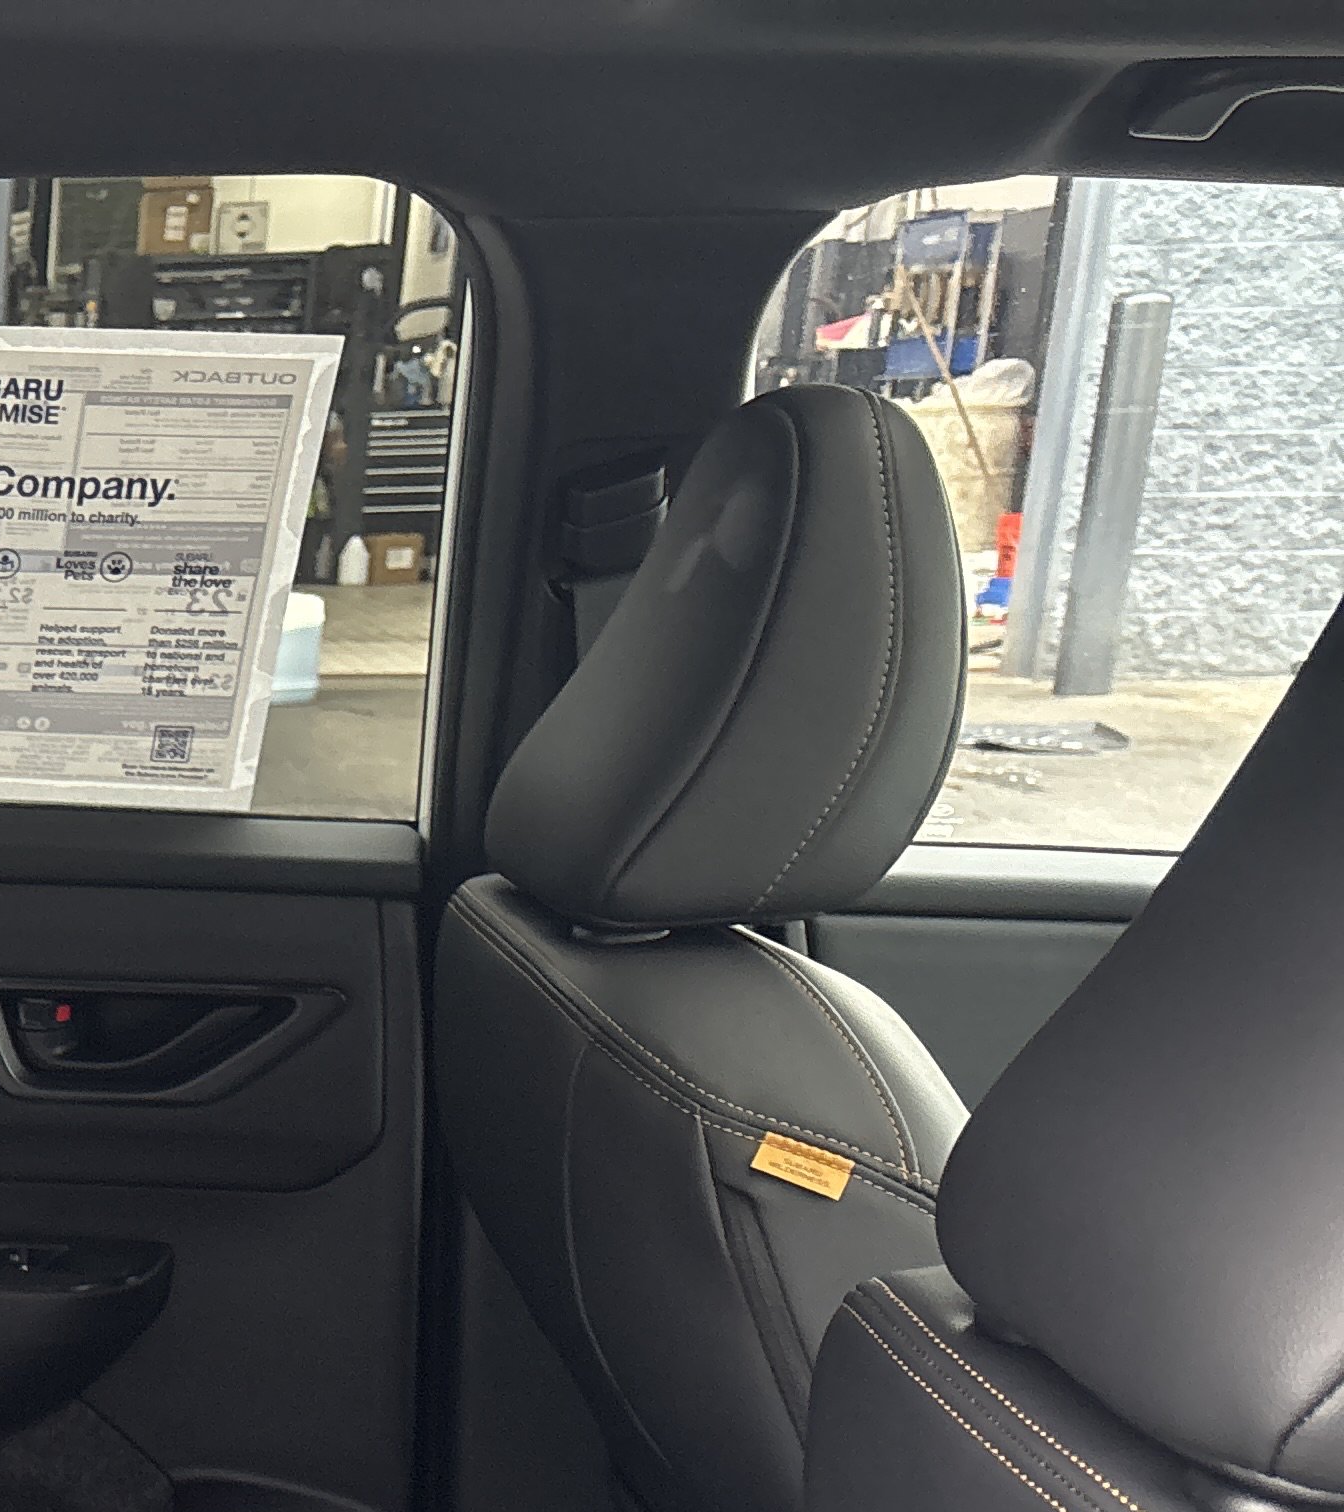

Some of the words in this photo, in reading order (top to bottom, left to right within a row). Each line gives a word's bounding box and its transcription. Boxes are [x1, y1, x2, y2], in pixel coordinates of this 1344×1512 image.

[18, 508, 66, 523] million
[71, 511, 85, 523] to
[89, 511, 141, 527] charity.
[55, 557, 96, 570] Loves
[173, 562, 221, 576] share
[63, 569, 94, 581] Pets
[171, 575, 199, 588] the
[199, 575, 234, 589] love
